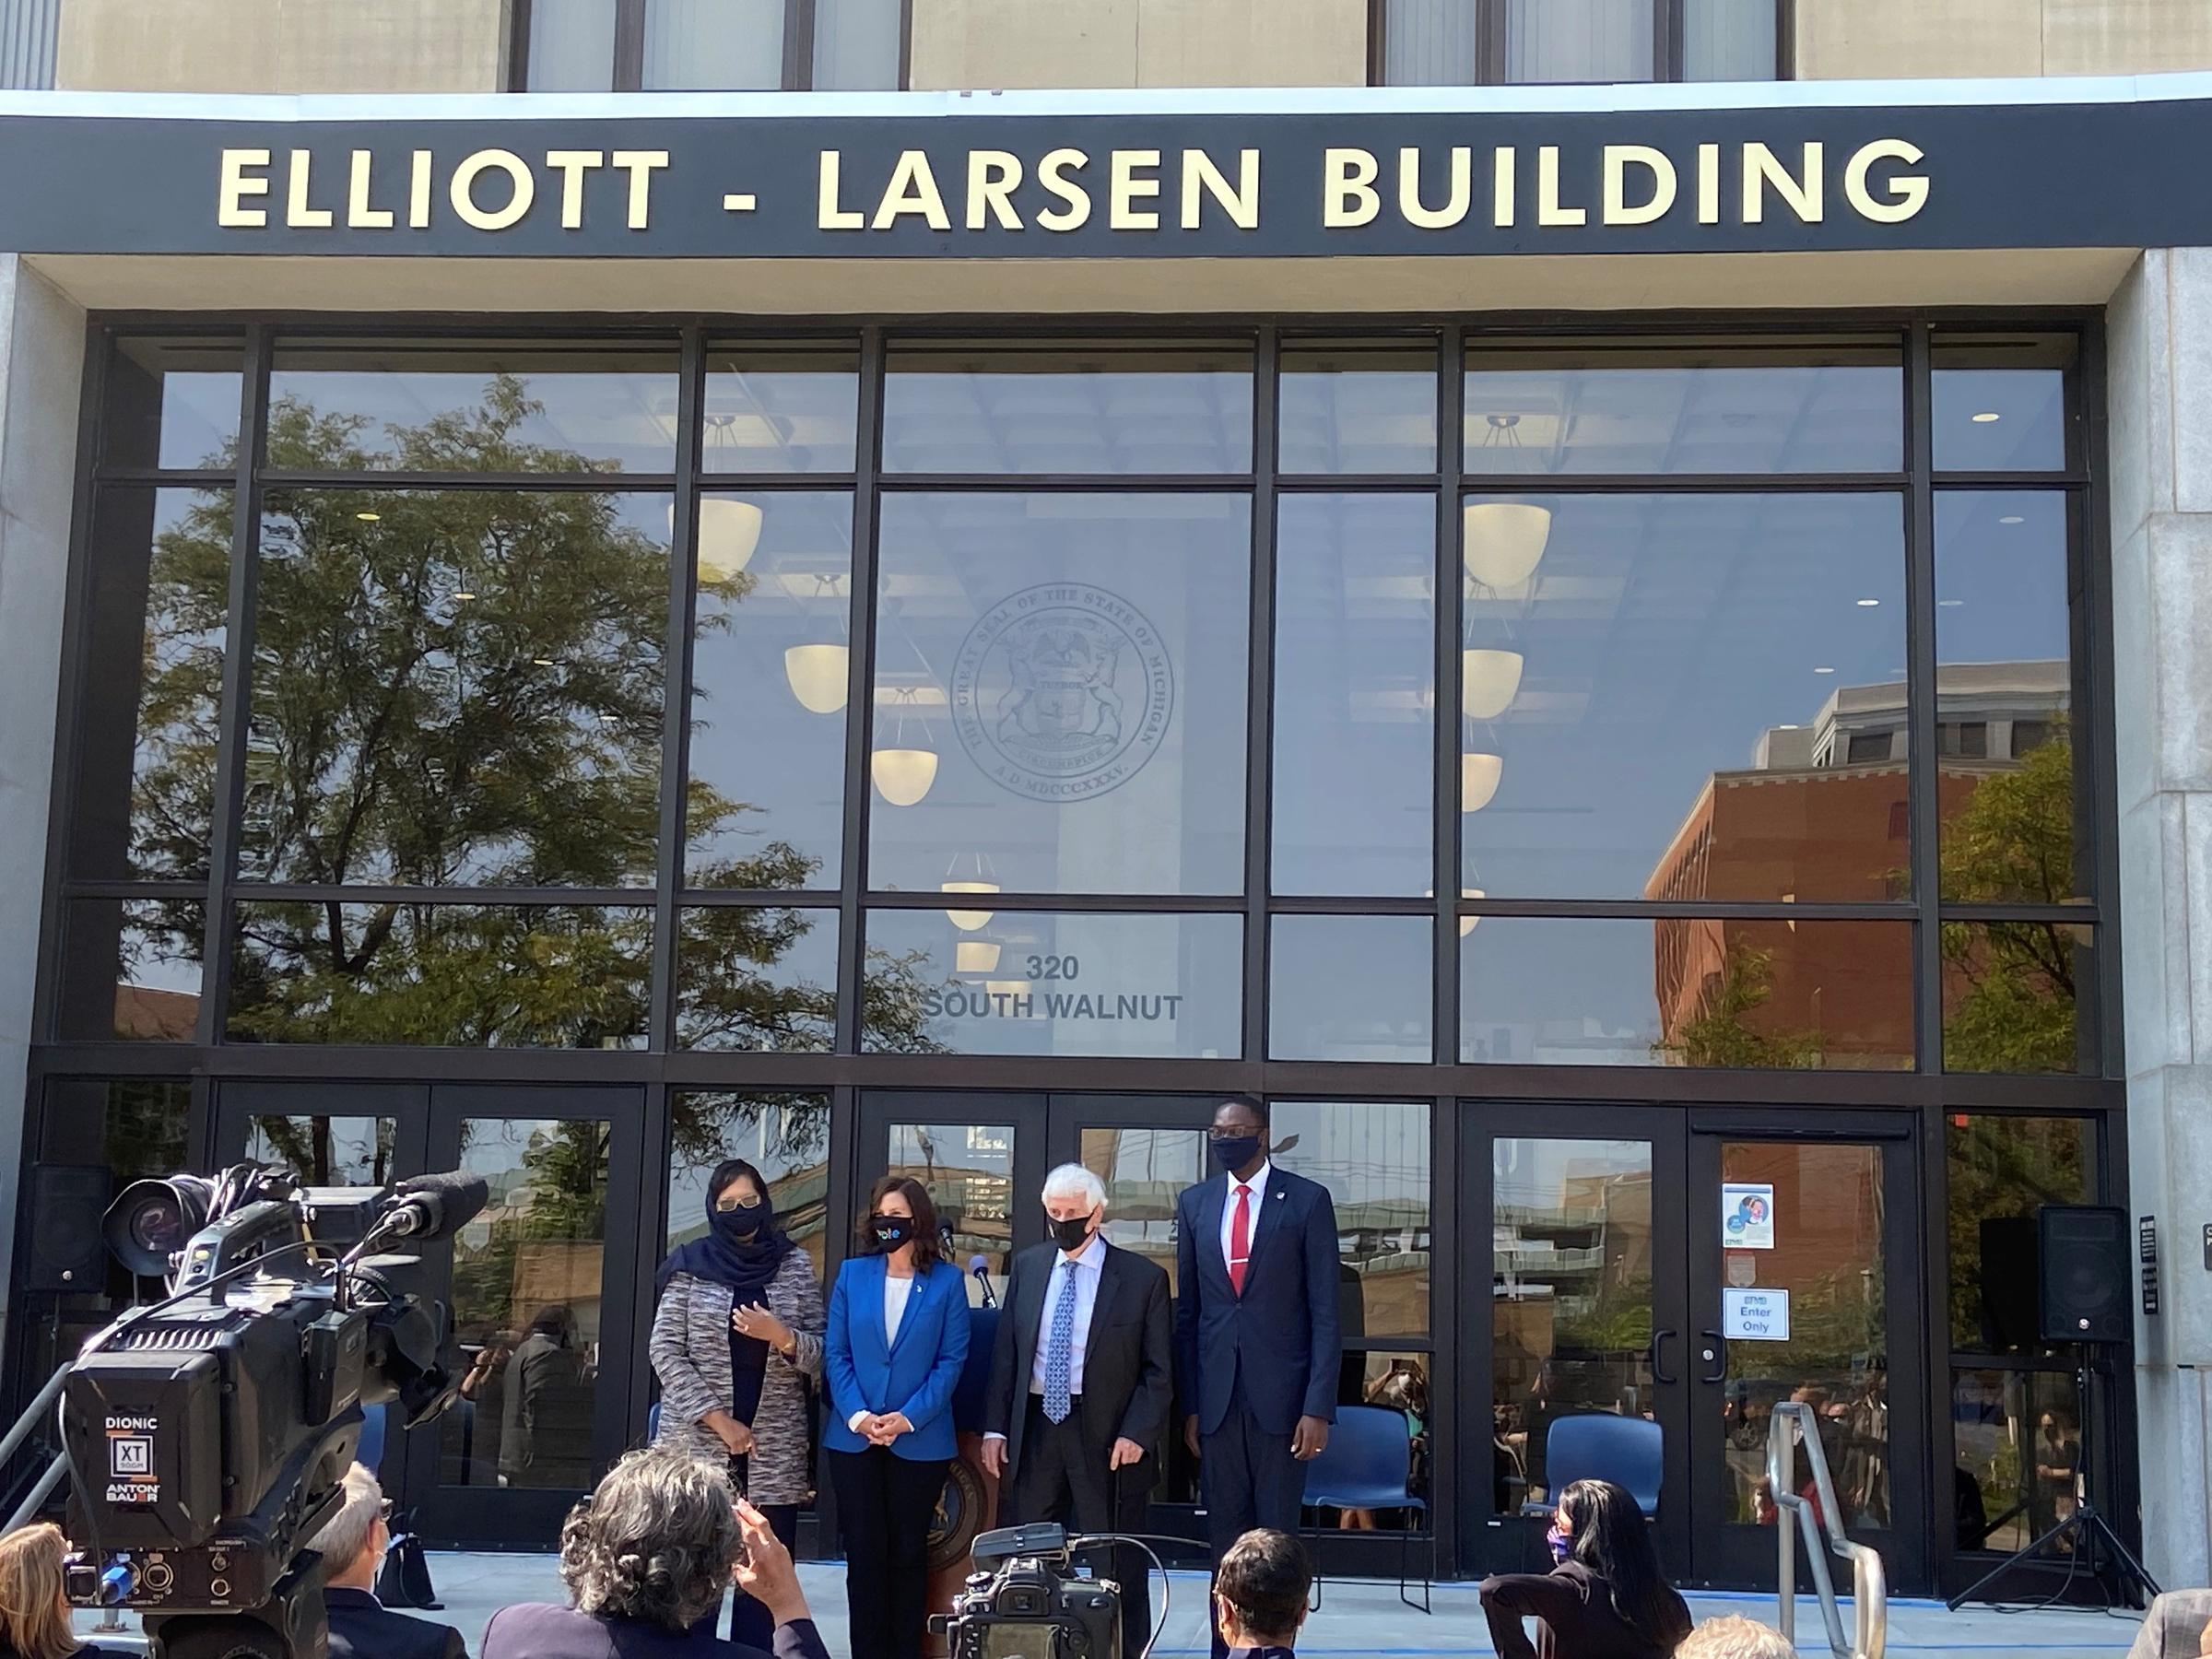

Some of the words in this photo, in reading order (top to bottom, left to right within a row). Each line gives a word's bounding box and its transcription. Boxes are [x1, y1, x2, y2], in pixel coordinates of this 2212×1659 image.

[218, 148, 669, 229] ELLIOTT
[818, 147, 1261, 231] LARSEN
[1324, 137, 1930, 229] BUILDING
[977, 609, 1013, 642] SEAL
[1017, 592, 1041, 609] OF
[1044, 589, 1078, 602] THE
[1083, 591, 1135, 628] STATE
[1140, 654, 1166, 747] MICHIGAN
[1026, 955, 1079, 980] 320
[923, 992, 1033, 1018] SOUTH
[1043, 994, 1183, 1020] WALNUT
[1740, 1306, 1771, 1317] Enter
[1743, 1321, 1770, 1334] Only
[105, 1417, 158, 1430] DIONIC
[121, 1445, 143, 1462] XT
[106, 1484, 159, 1493] ANTON
[106, 1492, 158, 1502] BAUER
